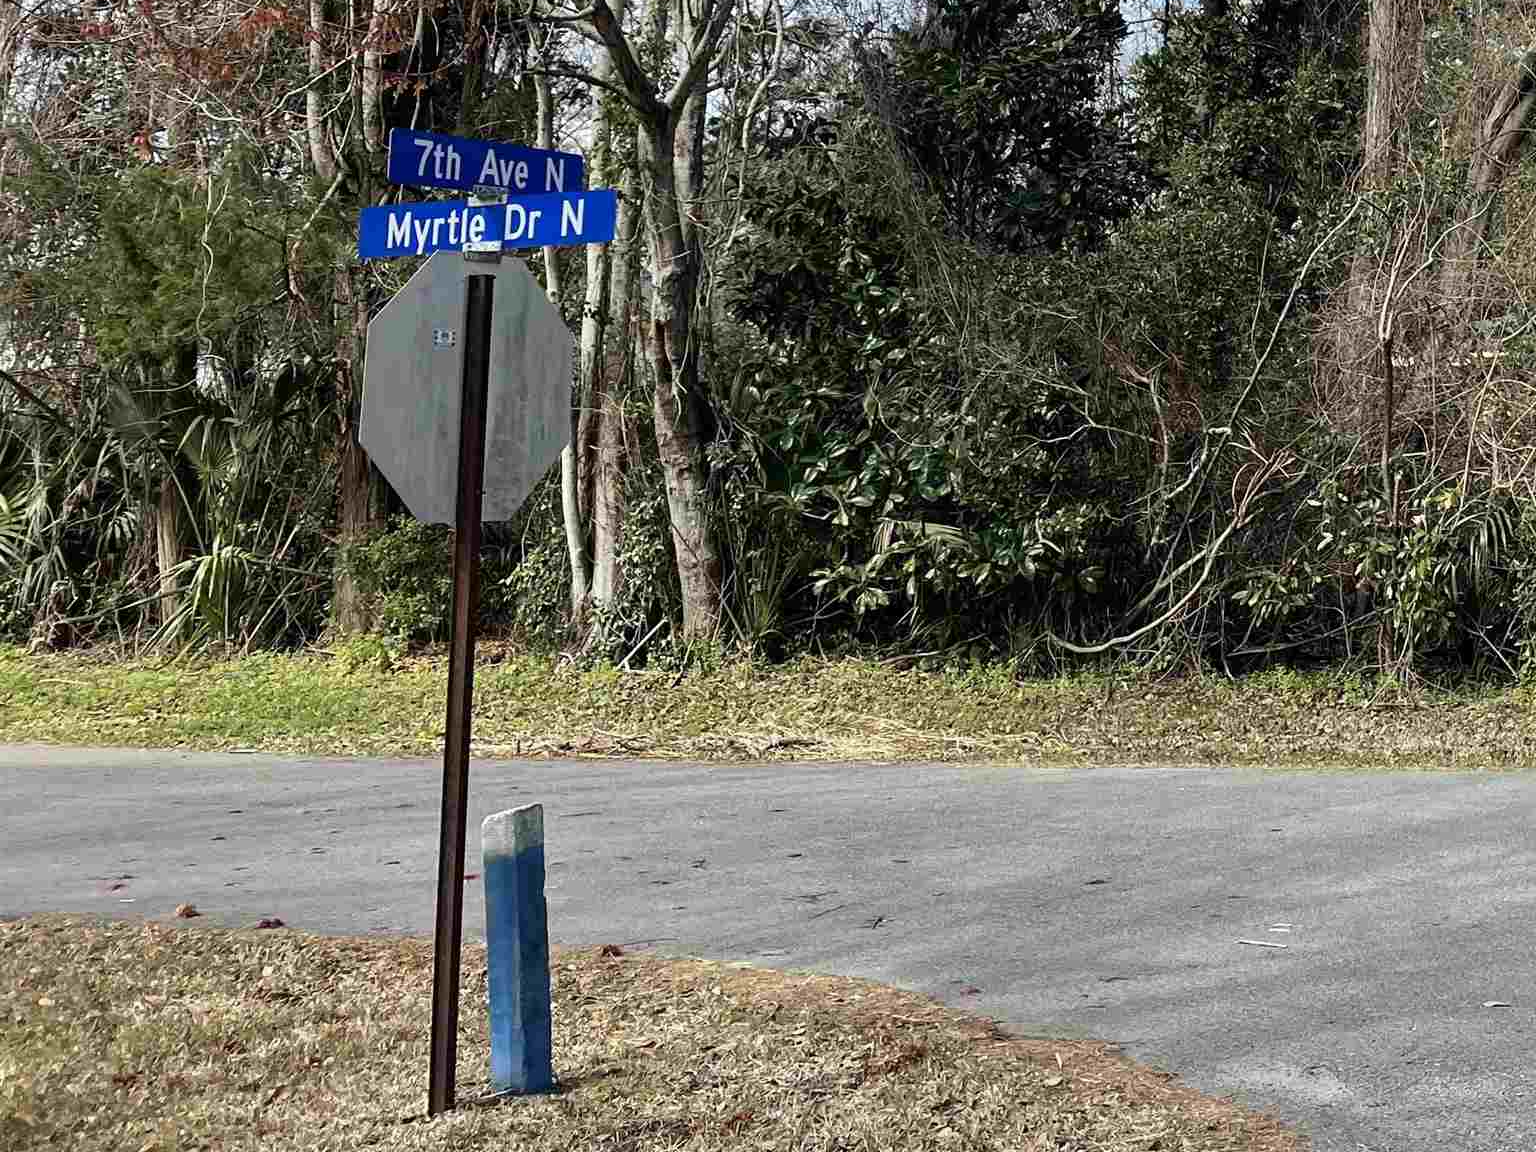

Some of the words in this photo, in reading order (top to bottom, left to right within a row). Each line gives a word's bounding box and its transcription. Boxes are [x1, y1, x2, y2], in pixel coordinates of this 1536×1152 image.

[414, 139, 461, 180] 7th
[479, 149, 529, 189] Ave
[545, 158, 565, 192] N
[387, 208, 486, 255] Myrtle
[504, 203, 542, 241] Dr
[561, 199, 585, 237] N
